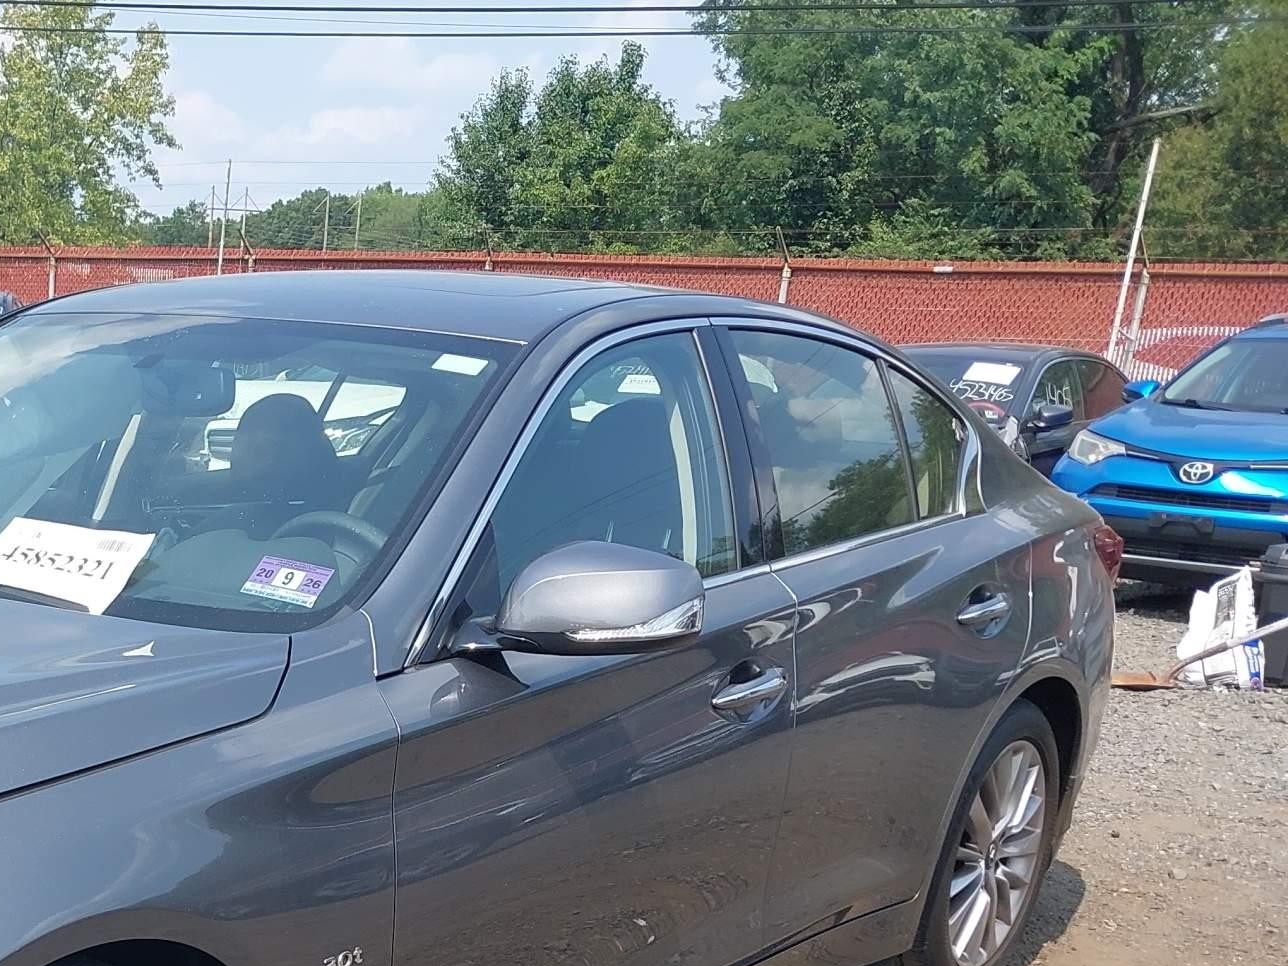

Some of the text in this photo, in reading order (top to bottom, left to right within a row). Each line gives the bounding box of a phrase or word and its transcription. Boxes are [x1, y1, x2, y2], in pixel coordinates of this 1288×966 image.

[0, 545, 115, 580] 45852321
[256, 567, 322, 589] 20 9 26
